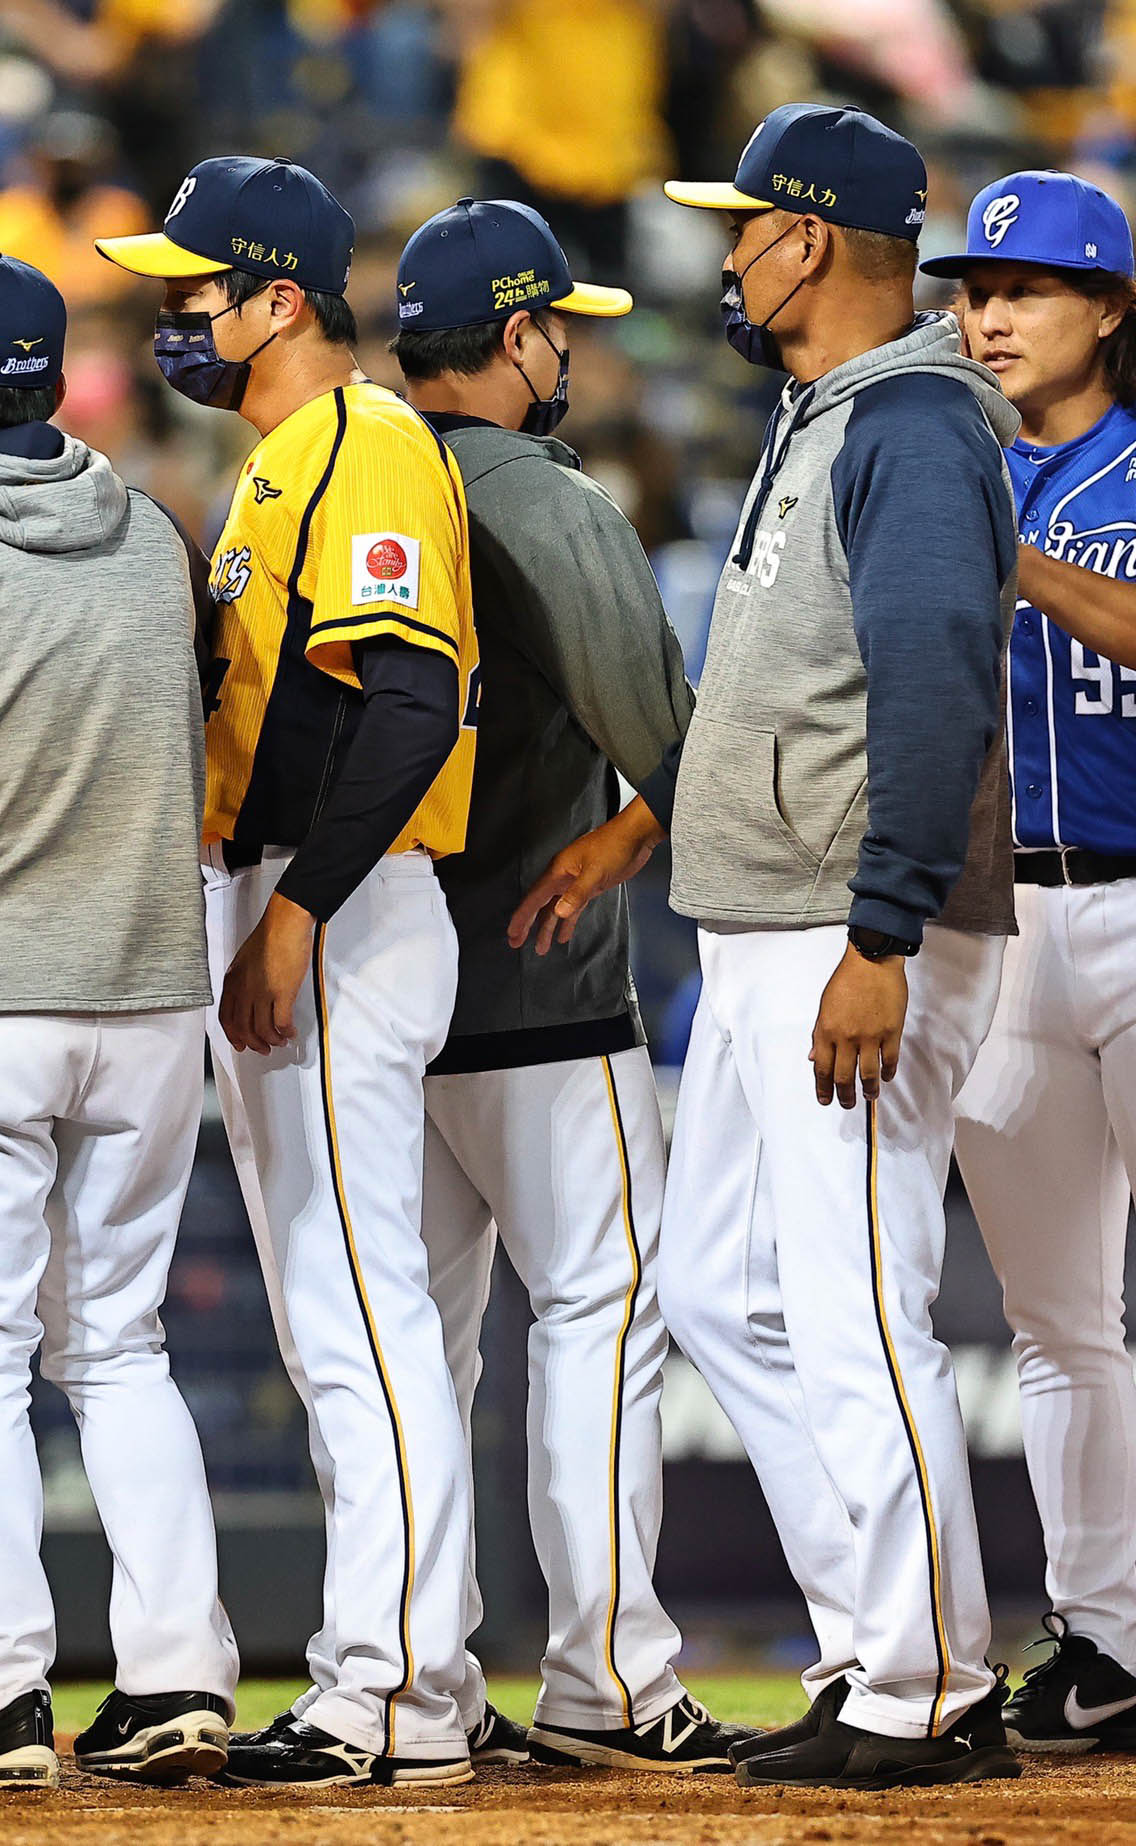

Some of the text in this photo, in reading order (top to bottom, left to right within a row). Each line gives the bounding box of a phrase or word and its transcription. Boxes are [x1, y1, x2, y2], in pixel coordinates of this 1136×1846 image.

[771, 173, 837, 208] 守信人力
[230, 236, 299, 271] 守信人力
[491, 273, 535, 293] PChome
[0, 355, 49, 375] Brothers
